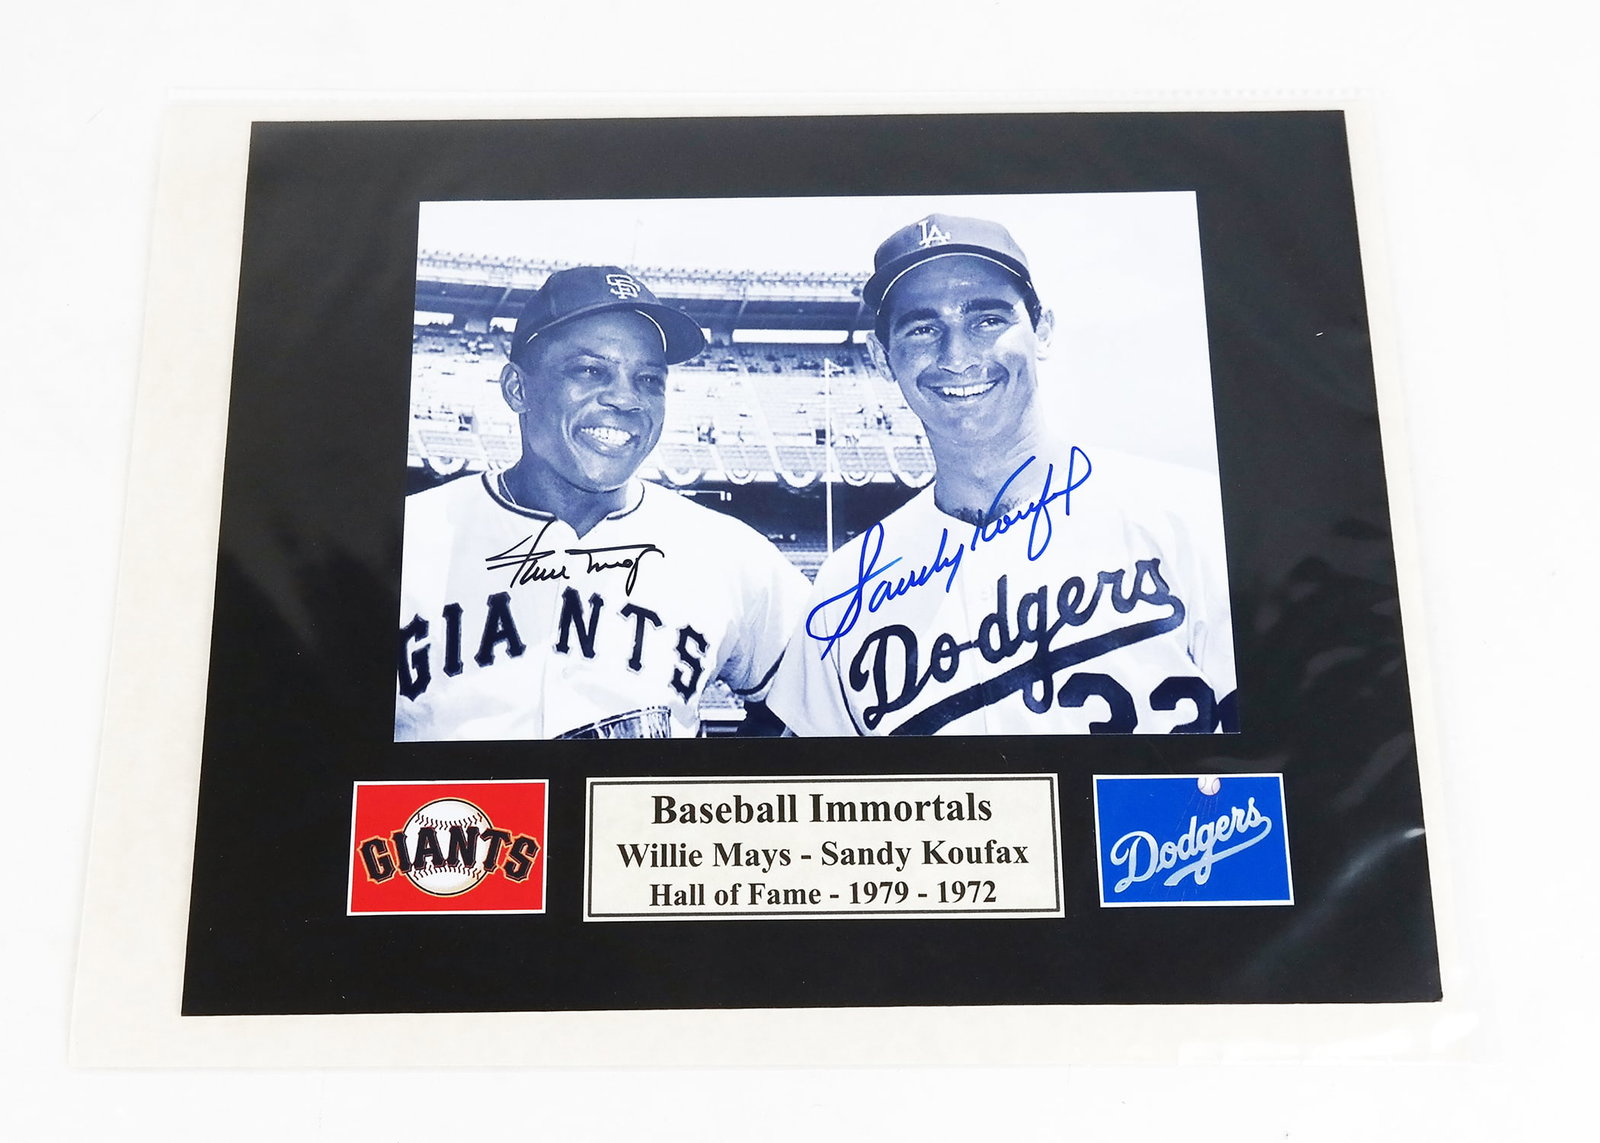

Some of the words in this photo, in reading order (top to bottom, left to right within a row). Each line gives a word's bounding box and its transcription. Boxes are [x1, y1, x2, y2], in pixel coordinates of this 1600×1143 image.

[918, 220, 951, 248] LA
[398, 585, 712, 703] GIANTS
[850, 557, 1185, 734] Dodgers
[651, 794, 799, 825] Baseball
[809, 792, 992, 823] Immortals
[358, 823, 541, 885] GIANTS
[616, 842, 703, 868] Willie
[712, 842, 792, 874] Mays
[821, 840, 912, 872] Sandy
[921, 839, 1029, 865] Koufax
[1110, 796, 1273, 894] Dodgers
[649, 883, 706, 907] Hall
[714, 882, 742, 906] of
[747, 882, 822, 906] Fame
[849, 881, 909, 905] 1979
[939, 880, 997, 904] 1972
